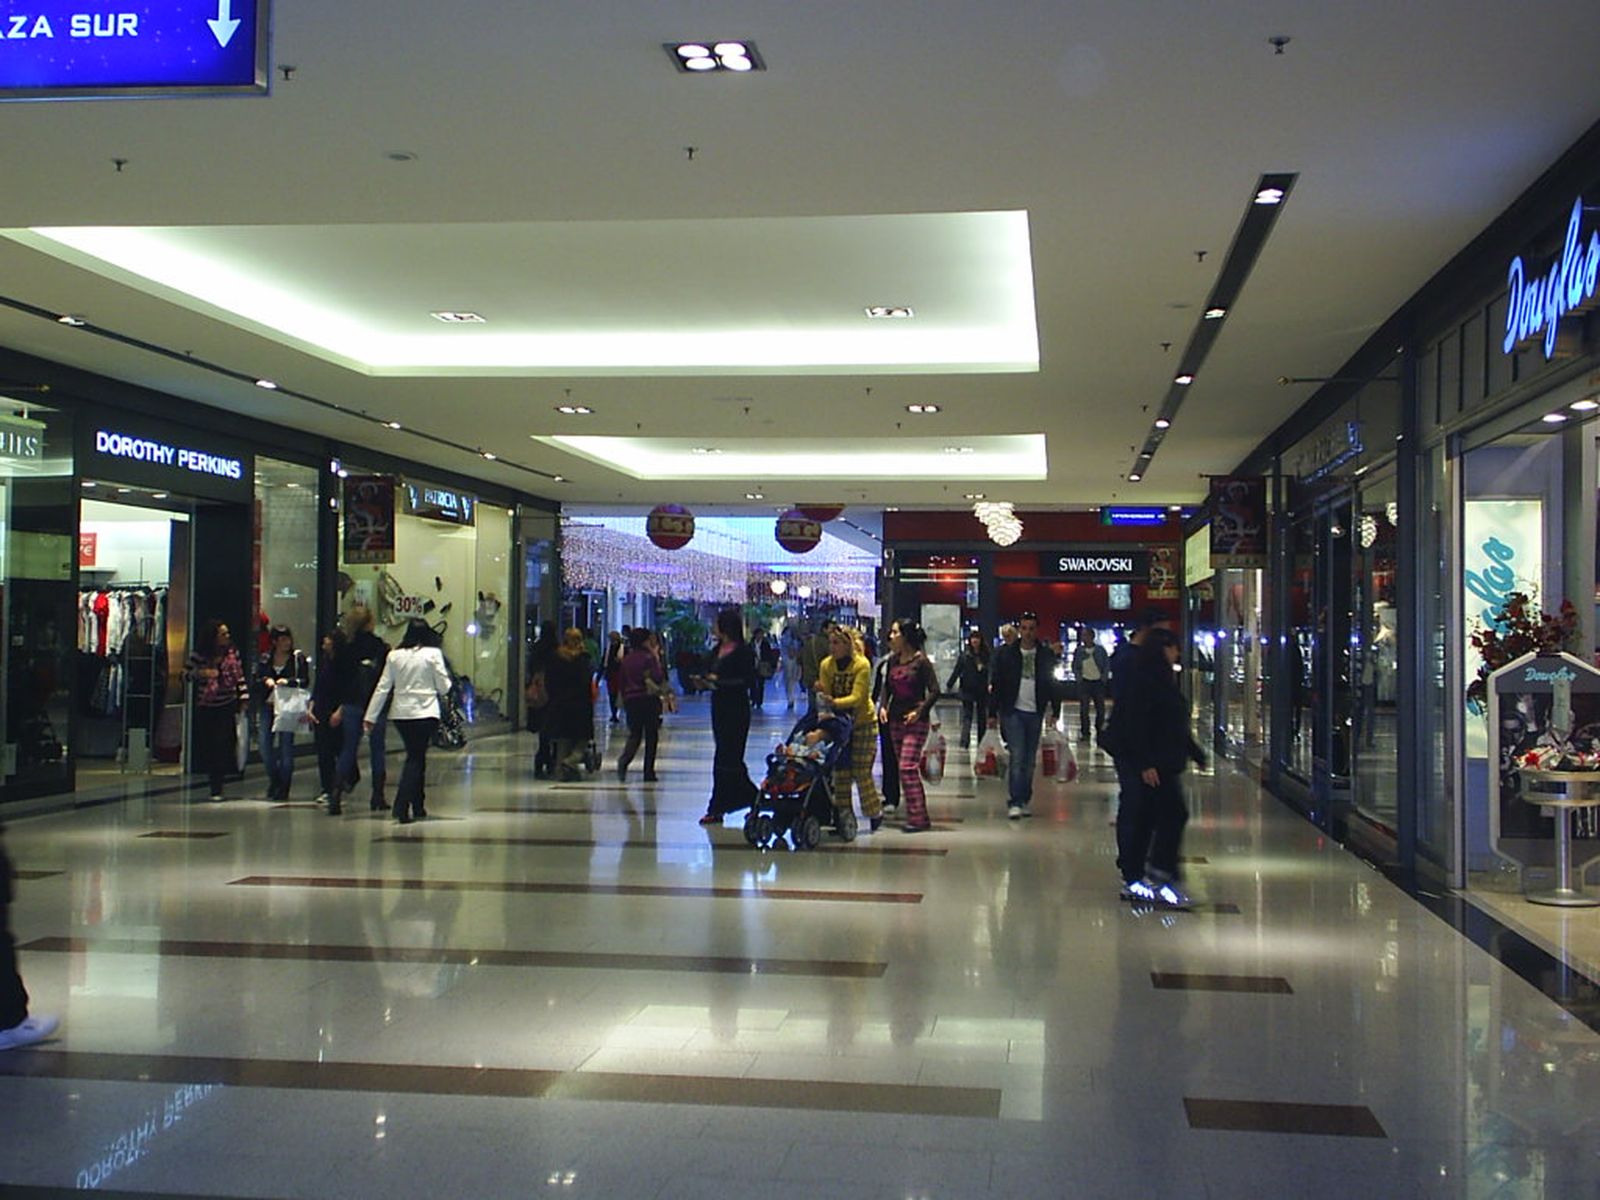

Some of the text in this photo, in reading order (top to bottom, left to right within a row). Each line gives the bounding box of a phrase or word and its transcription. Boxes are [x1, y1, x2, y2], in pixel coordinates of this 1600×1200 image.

[70, 13, 138, 37] SUR
[96, 430, 243, 480] DOROTHY PERKINS
[1058, 557, 1133, 572] SWAROVSKI
[395, 596, 423, 614] 30%
